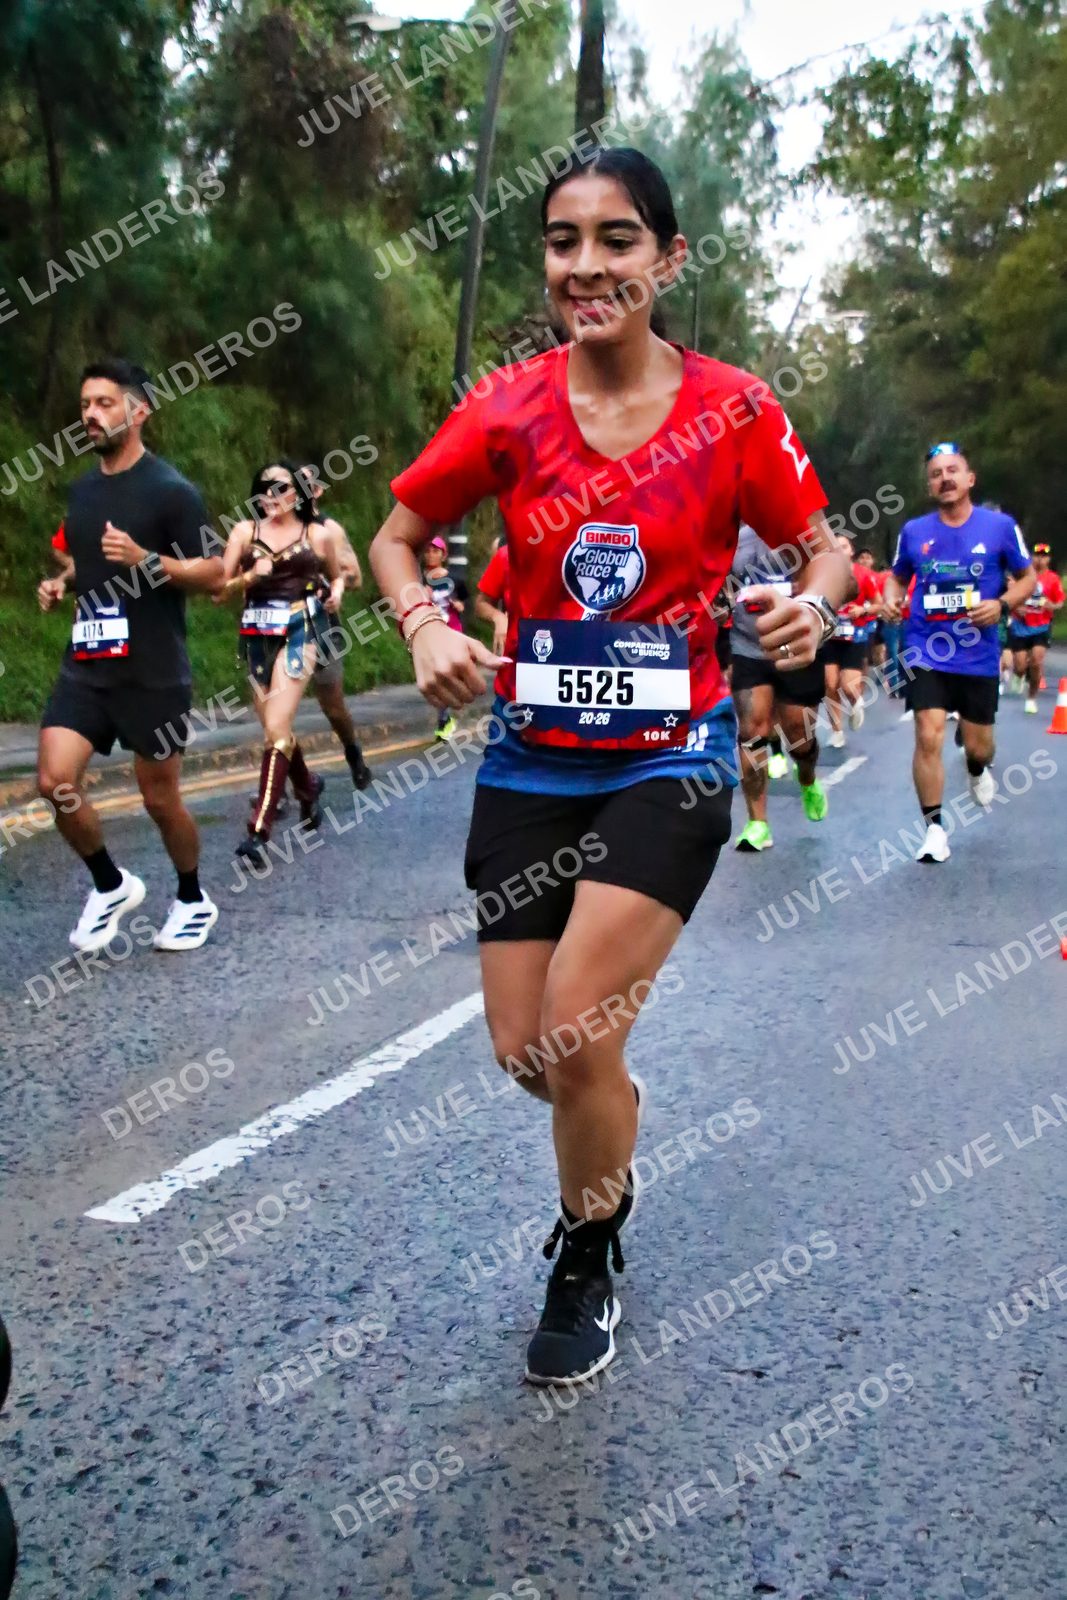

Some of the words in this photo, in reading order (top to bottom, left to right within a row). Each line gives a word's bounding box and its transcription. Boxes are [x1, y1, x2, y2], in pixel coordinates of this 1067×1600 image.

[585, 532, 631, 546] BIMBO
[585, 549, 629, 567] Global
[575, 562, 611, 578] Race
[613, 640, 670, 651] COMPARTIMOS
[558, 669, 634, 706] 5525
[643, 730, 671, 741] 10K
